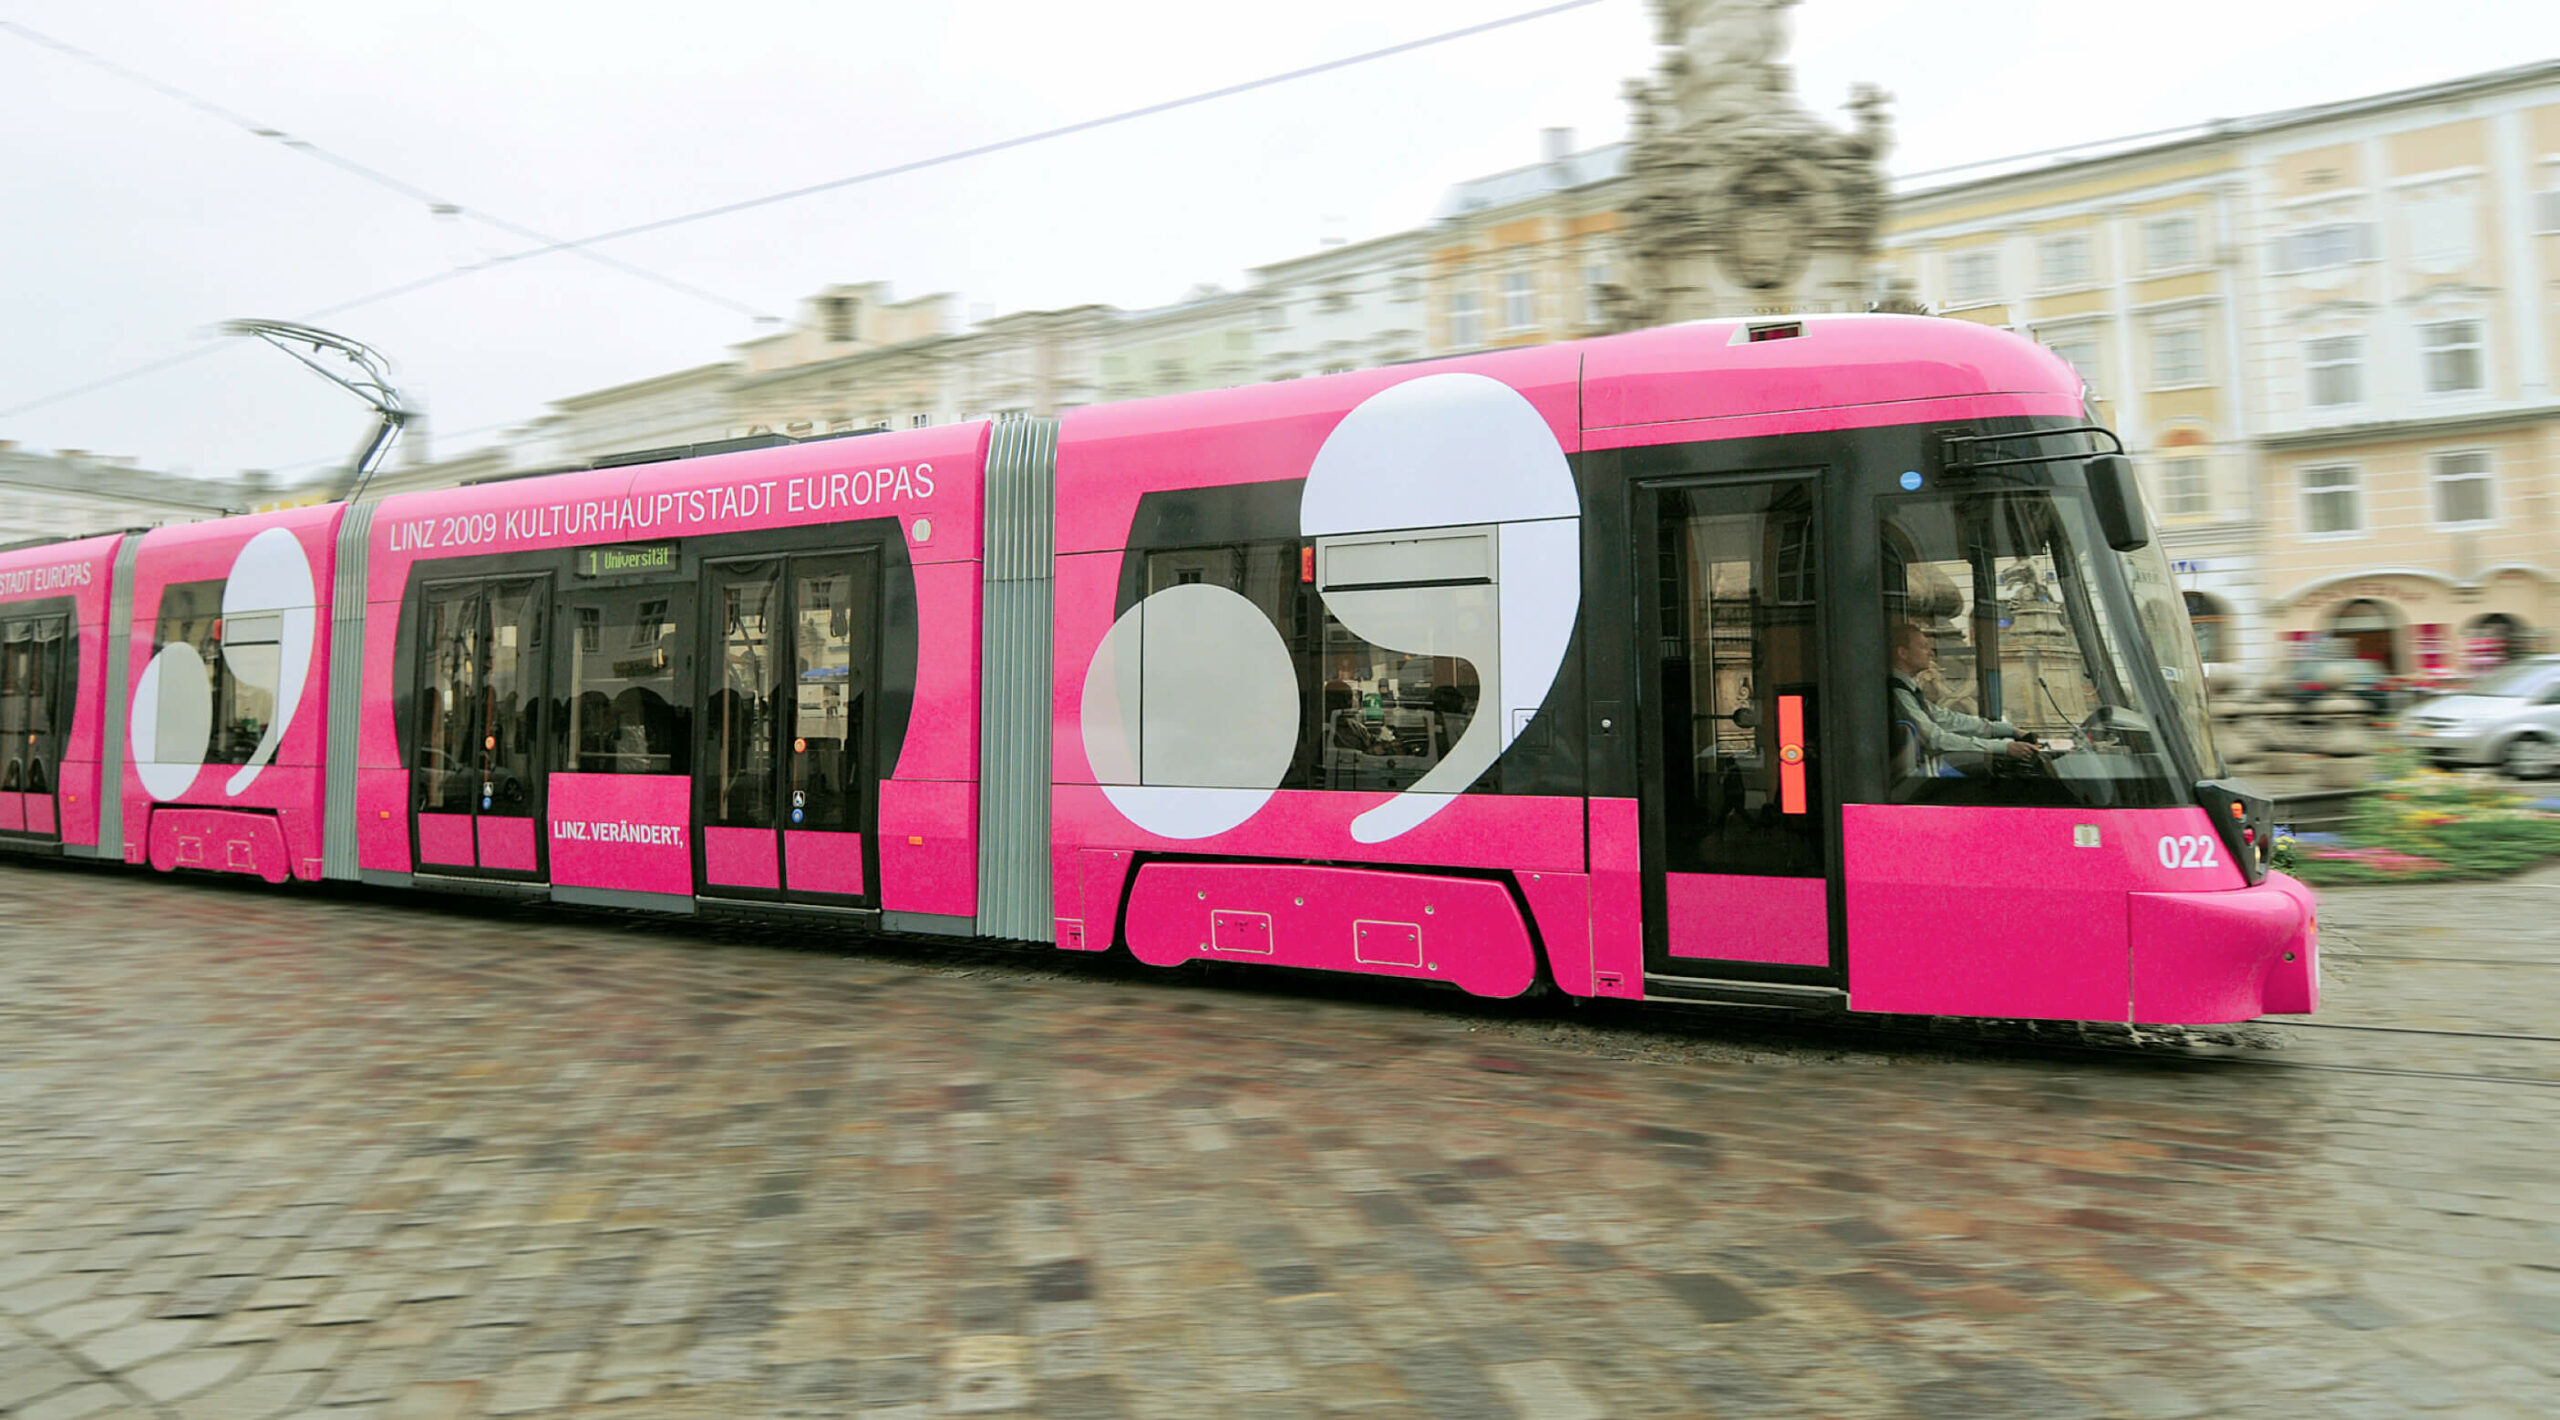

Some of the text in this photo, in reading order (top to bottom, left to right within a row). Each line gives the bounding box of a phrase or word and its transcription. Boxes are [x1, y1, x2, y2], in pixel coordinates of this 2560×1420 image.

[390, 462, 936, 551] LINZ 2009 KULTURHAUPTSTADT EUROPAS
[34, 561, 92, 592] EUROPAS
[589, 546, 669, 576] 1 Universität
[2158, 834, 2219, 870] 022
